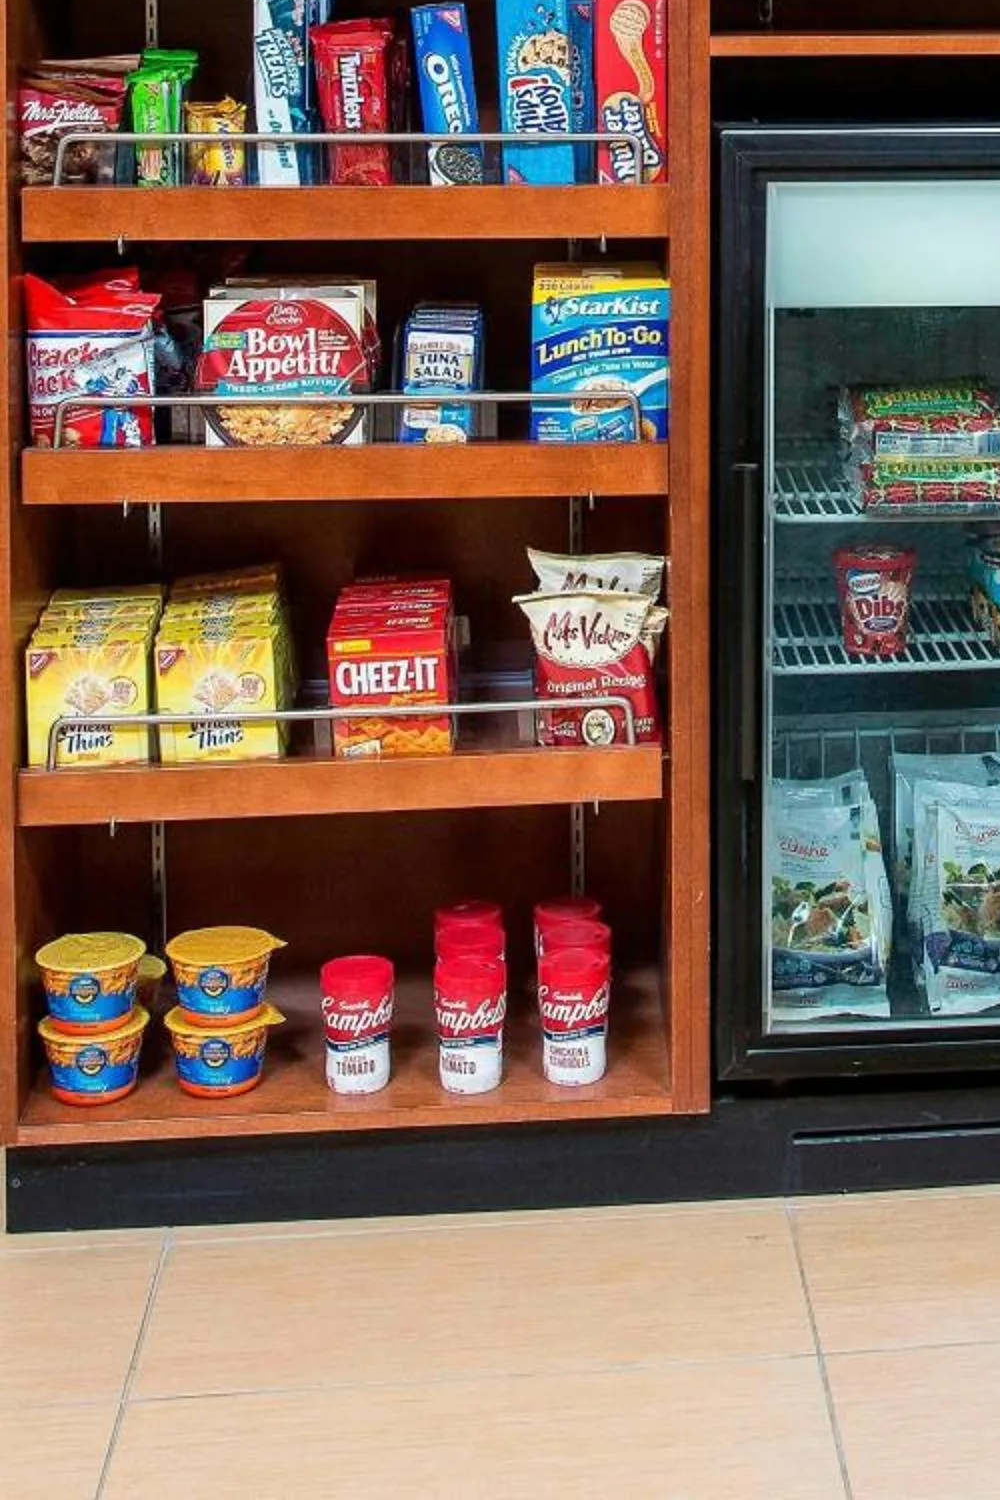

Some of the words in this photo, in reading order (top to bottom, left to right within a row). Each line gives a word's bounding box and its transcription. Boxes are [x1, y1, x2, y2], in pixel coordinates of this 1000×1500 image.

[255, 30, 289, 98] TREATS
[338, 52, 364, 129] Twizzlers
[424, 52, 465, 133] OREO
[513, 88, 540, 134] hips
[603, 109, 635, 179] Nuter
[560, 295, 661, 316] StarKist
[245, 327, 317, 356] Bowl
[419, 353, 460, 367] TUNA
[535, 330, 603, 365] Lunch
[602, 325, 663, 348] To-Go
[413, 365, 464, 380] SALAD
[335, 656, 439, 696] CHEEZ-IT
[546, 675, 598, 695] Original
[188, 729, 244, 750] Thins
